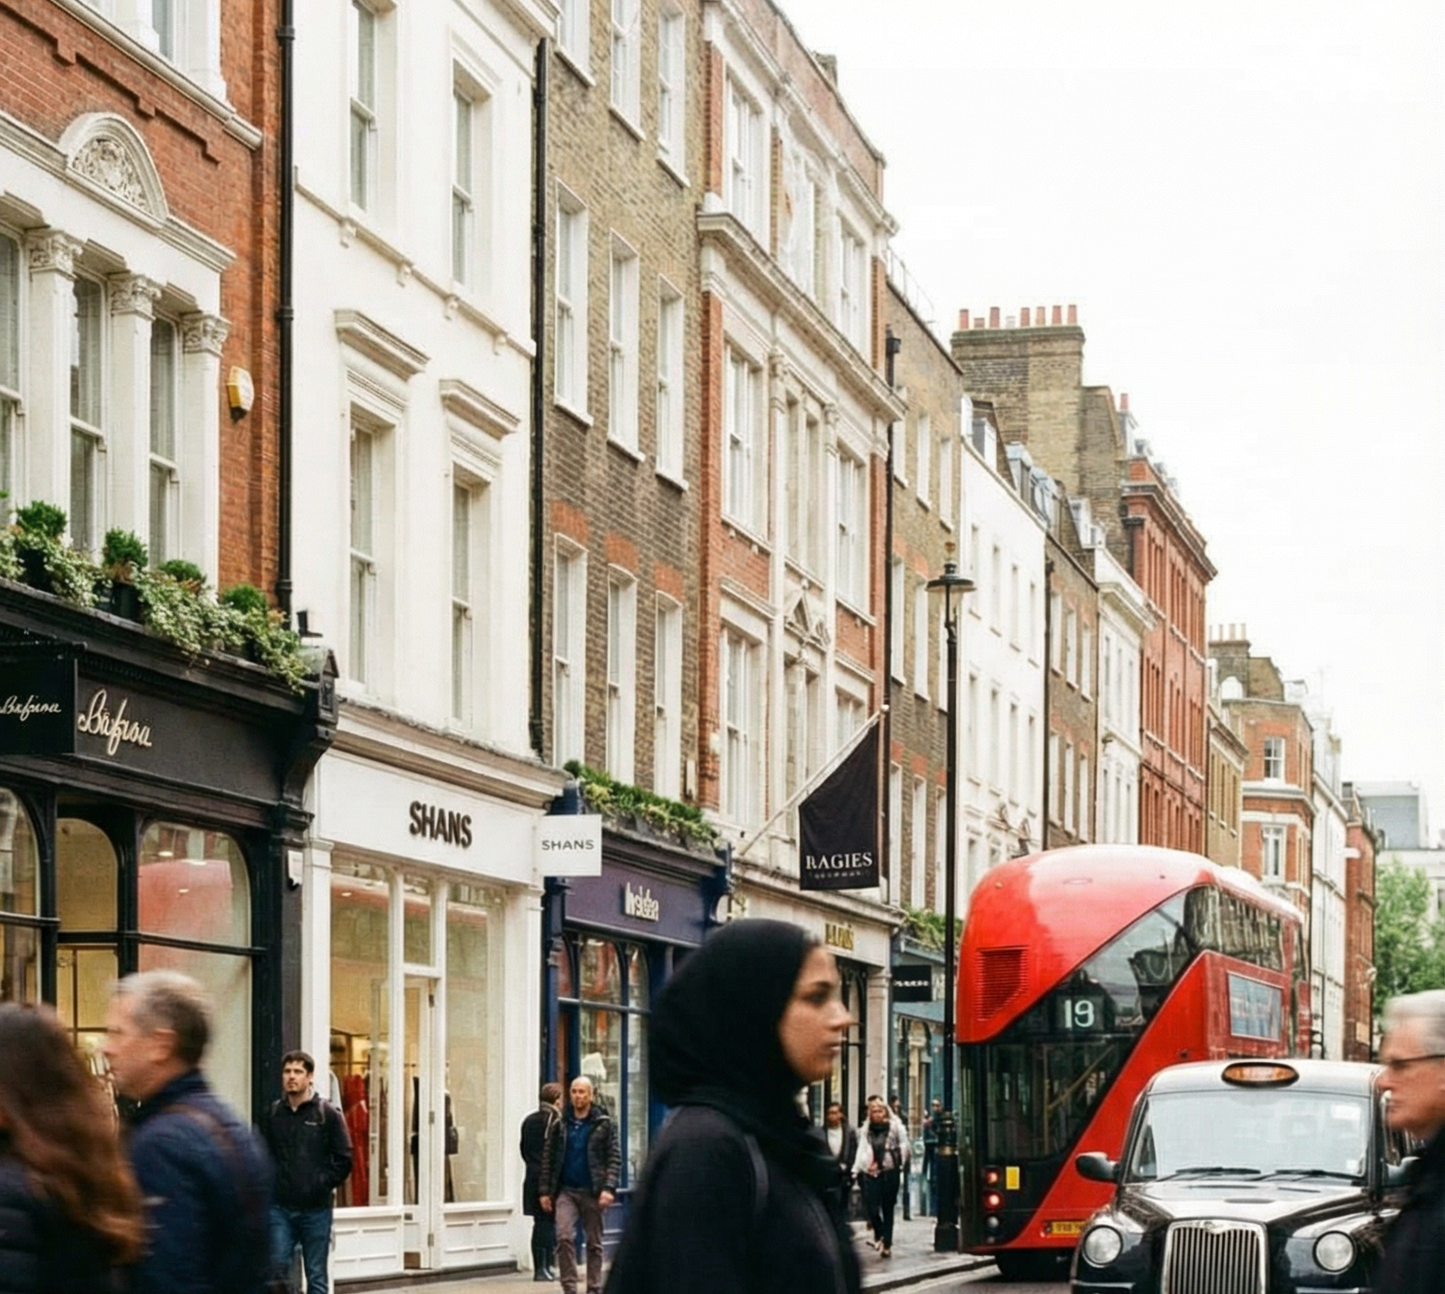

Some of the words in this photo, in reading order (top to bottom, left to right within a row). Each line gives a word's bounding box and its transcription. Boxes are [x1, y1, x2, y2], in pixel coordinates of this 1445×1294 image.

[409, 801, 472, 849] SHANS
[541, 839, 595, 851] SHANS
[806, 852, 873, 869] RAGIES
[1065, 999, 1095, 1028] 19
